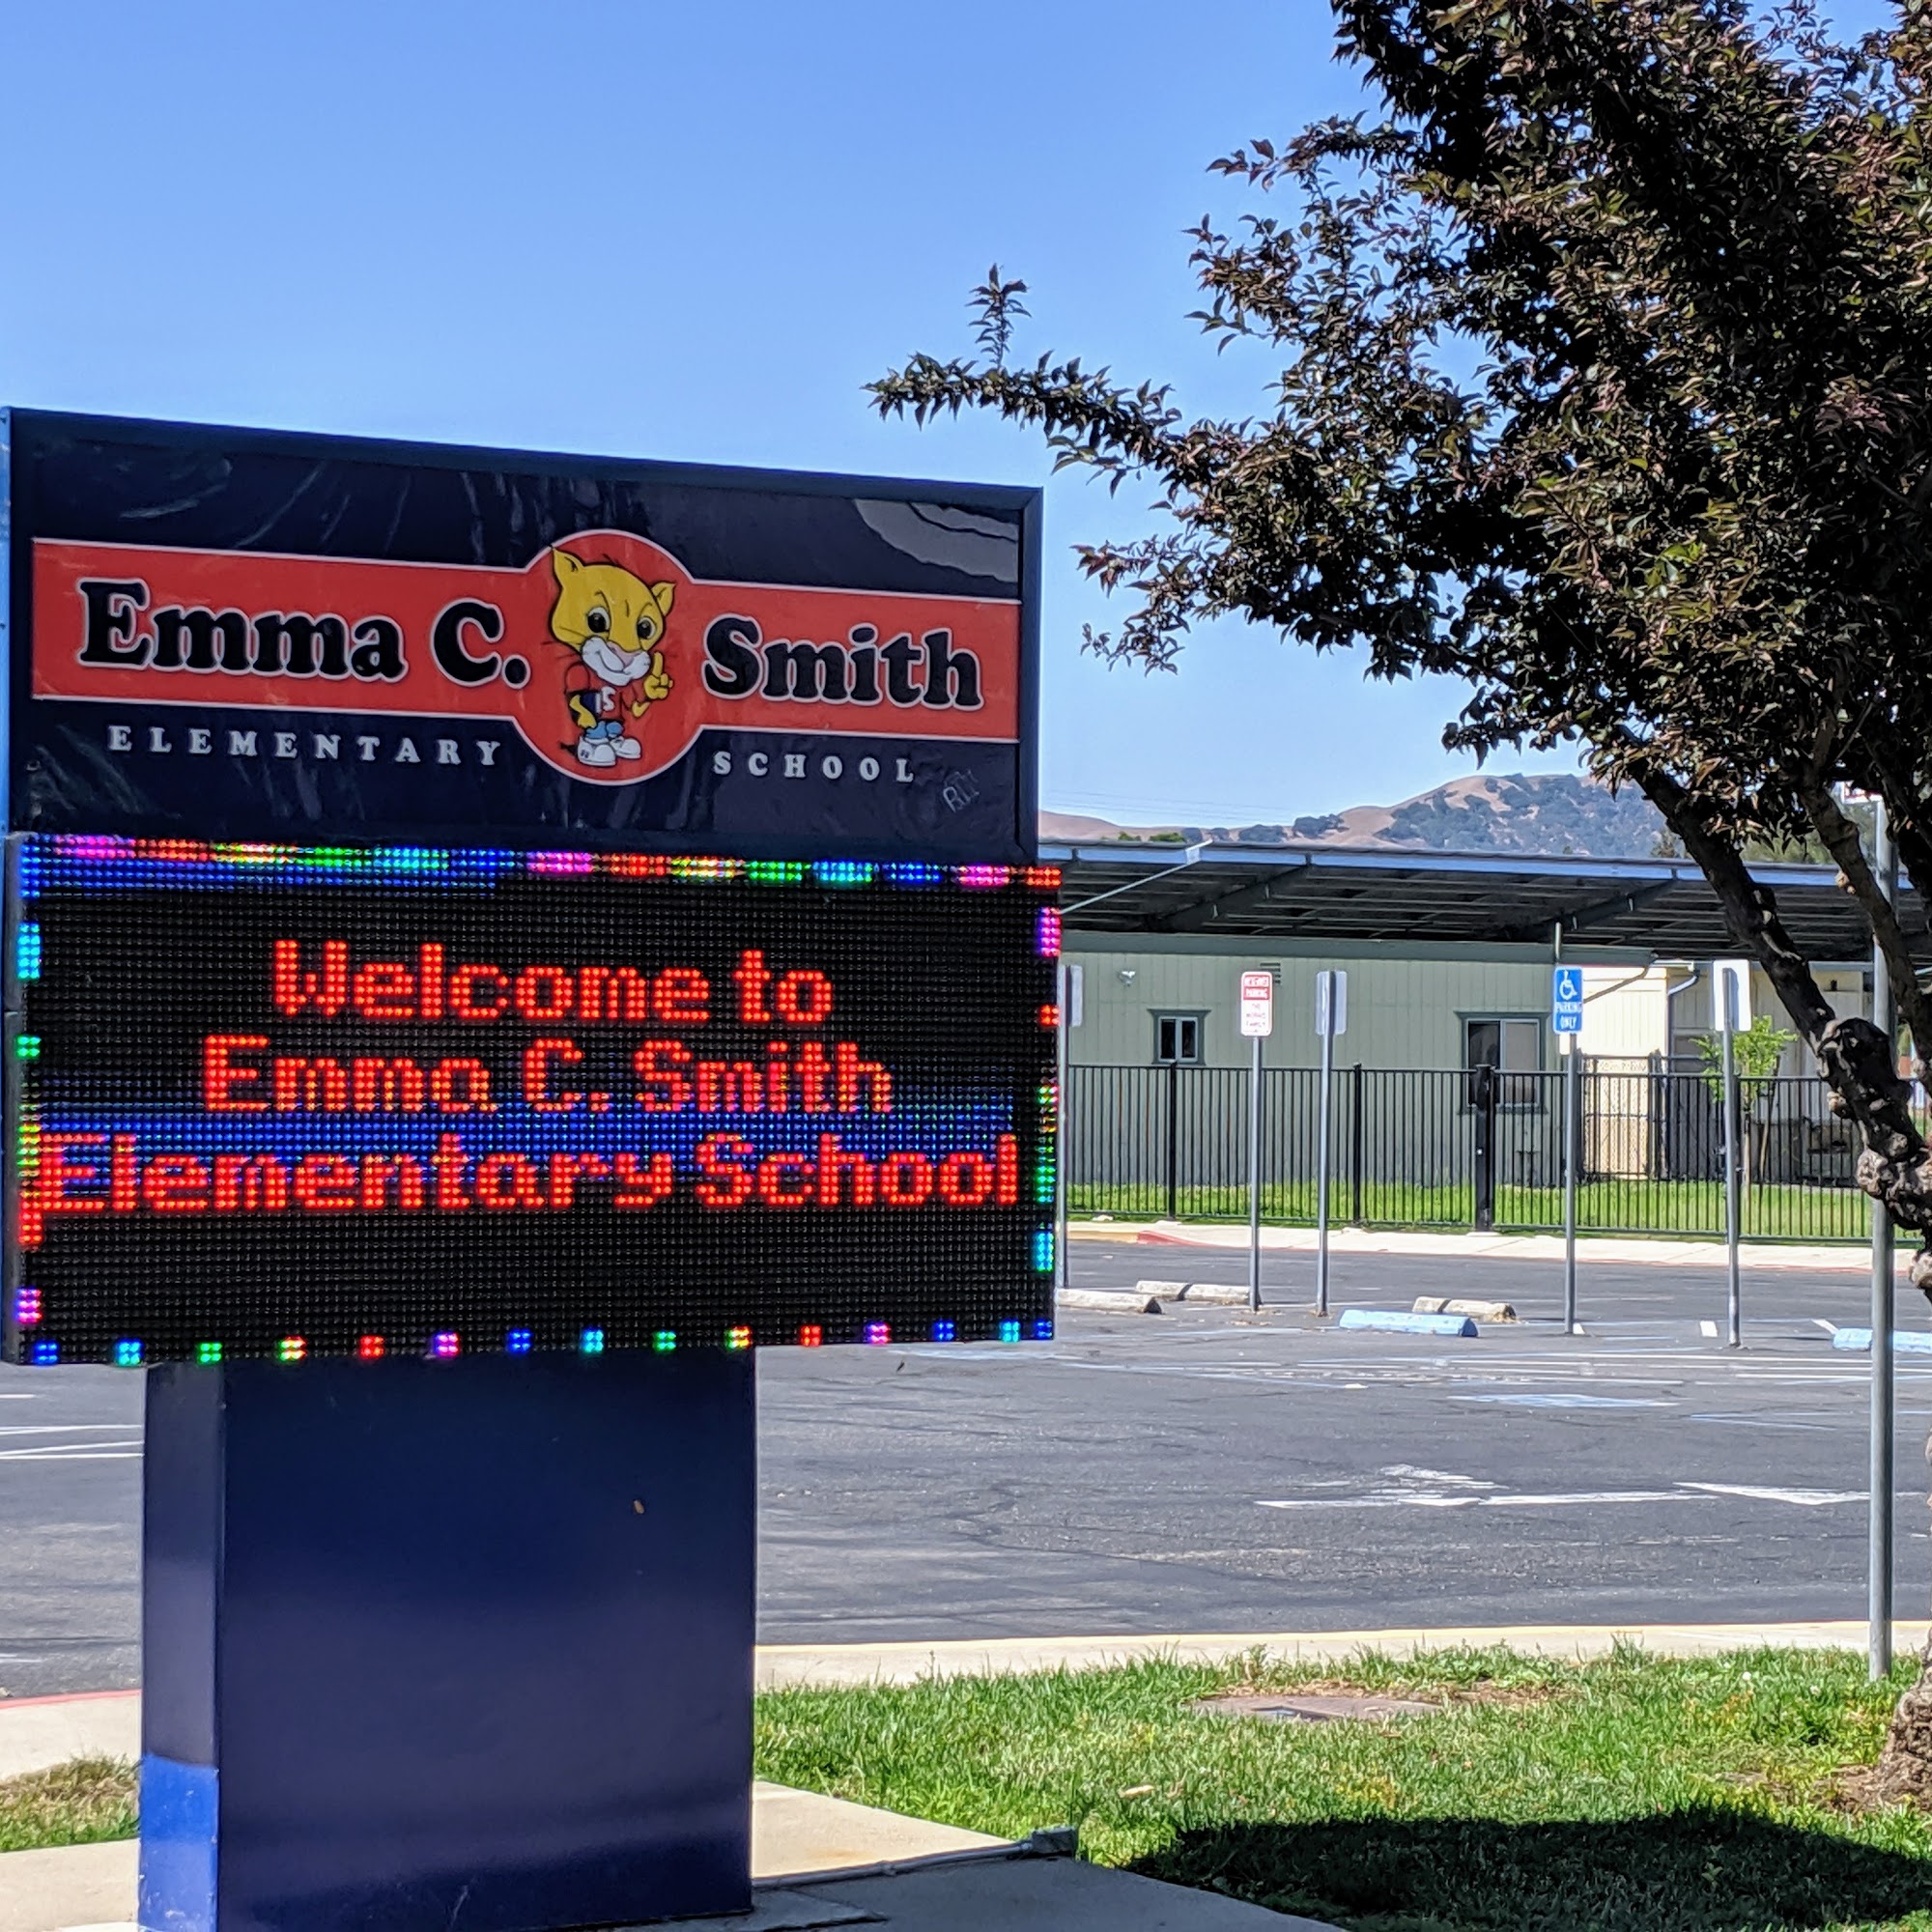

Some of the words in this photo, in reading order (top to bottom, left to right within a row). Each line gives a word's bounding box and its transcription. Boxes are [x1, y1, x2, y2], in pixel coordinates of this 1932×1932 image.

[74, 577, 409, 683] Emma
[429, 596, 531, 690] C.
[700, 611, 985, 712] Smith
[106, 724, 502, 767] ELEMENTARY
[712, 749, 915, 783] SCHOOL
[273, 939, 711, 1023] Welcome
[733, 948, 834, 1023] to
[204, 1033, 494, 1113] Emma
[522, 1038, 611, 1113] C.
[633, 1038, 895, 1114] Smith
[40, 1132, 674, 1210] Elementary
[695, 1132, 1018, 1206] School
